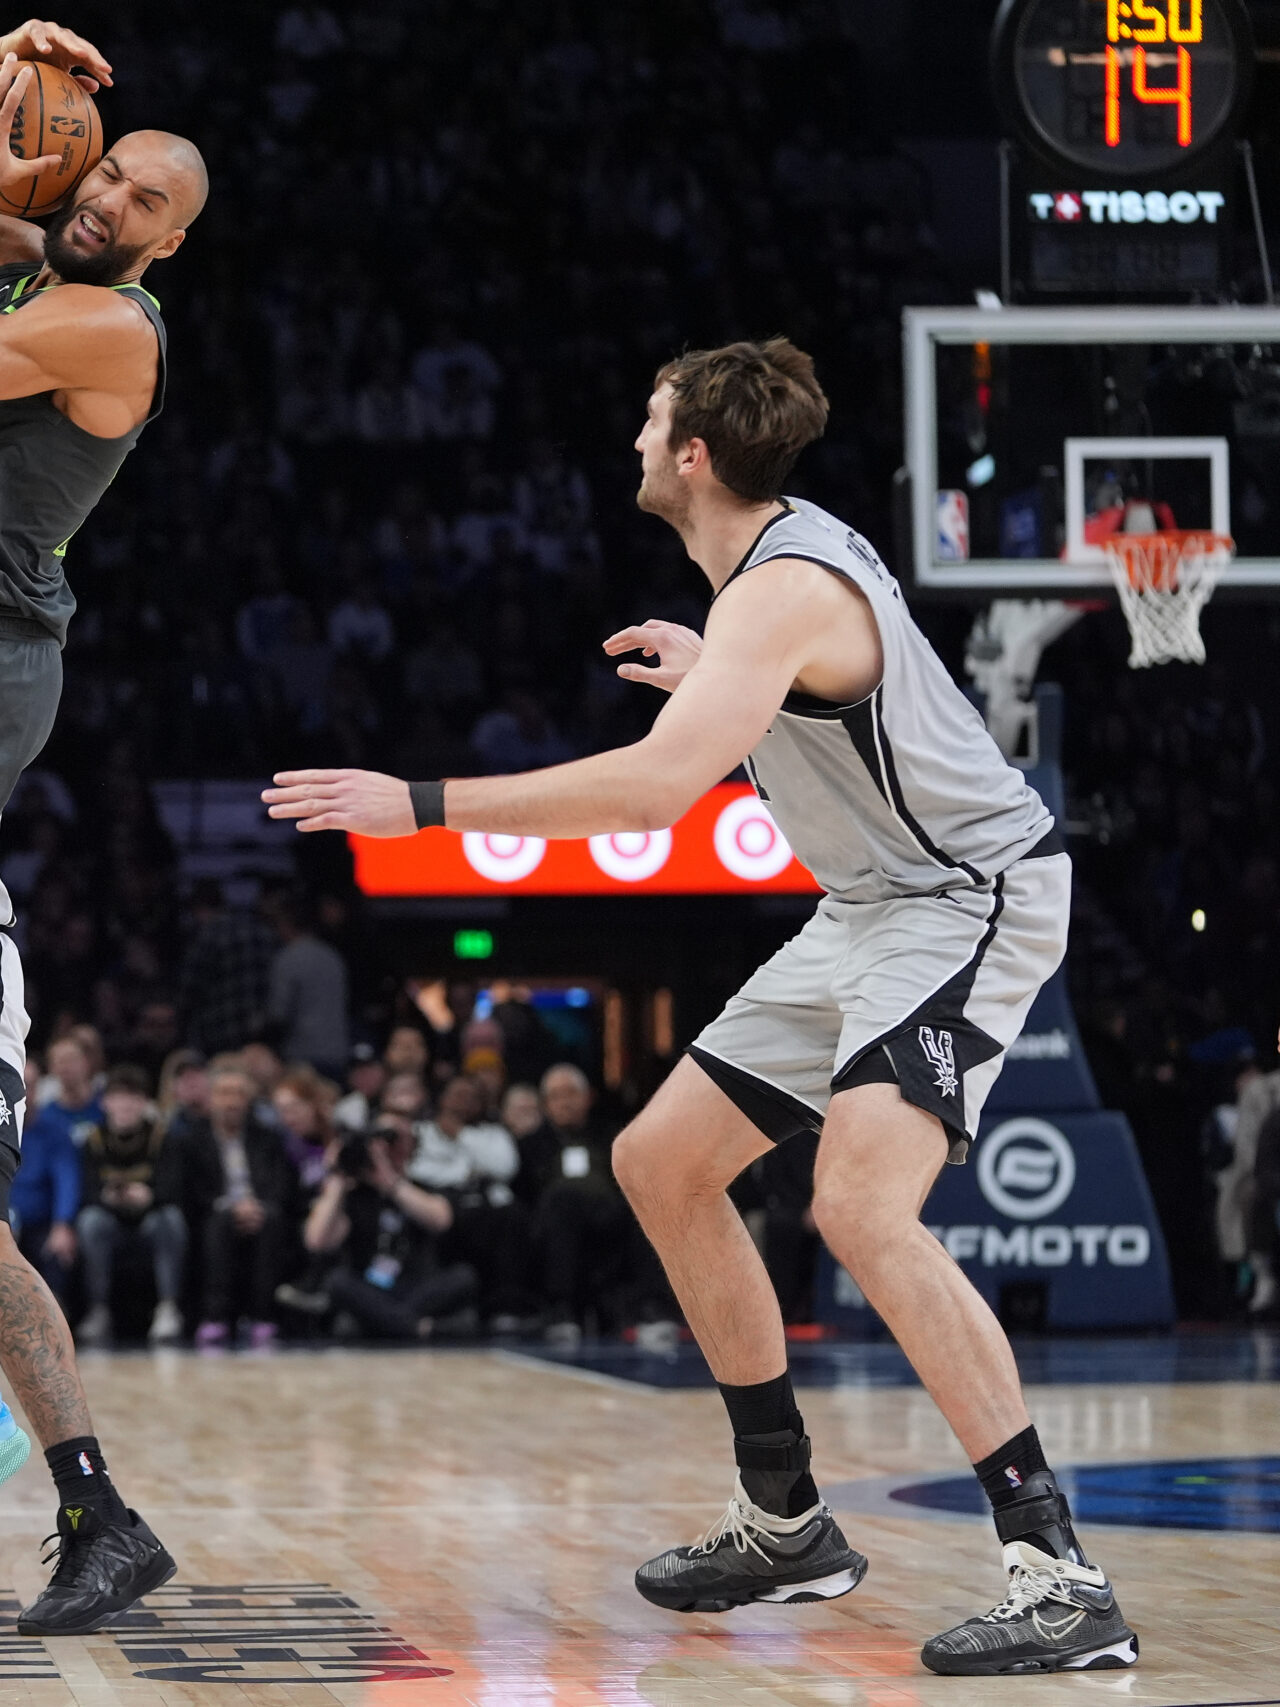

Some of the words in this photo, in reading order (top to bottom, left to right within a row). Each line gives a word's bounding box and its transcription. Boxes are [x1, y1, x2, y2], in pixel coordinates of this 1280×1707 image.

[1106, 0, 1202, 43] 1:50
[1105, 44, 1191, 147] 14
[1081, 190, 1225, 224] TISSOT
[926, 1225, 1152, 1267] FMOTO
